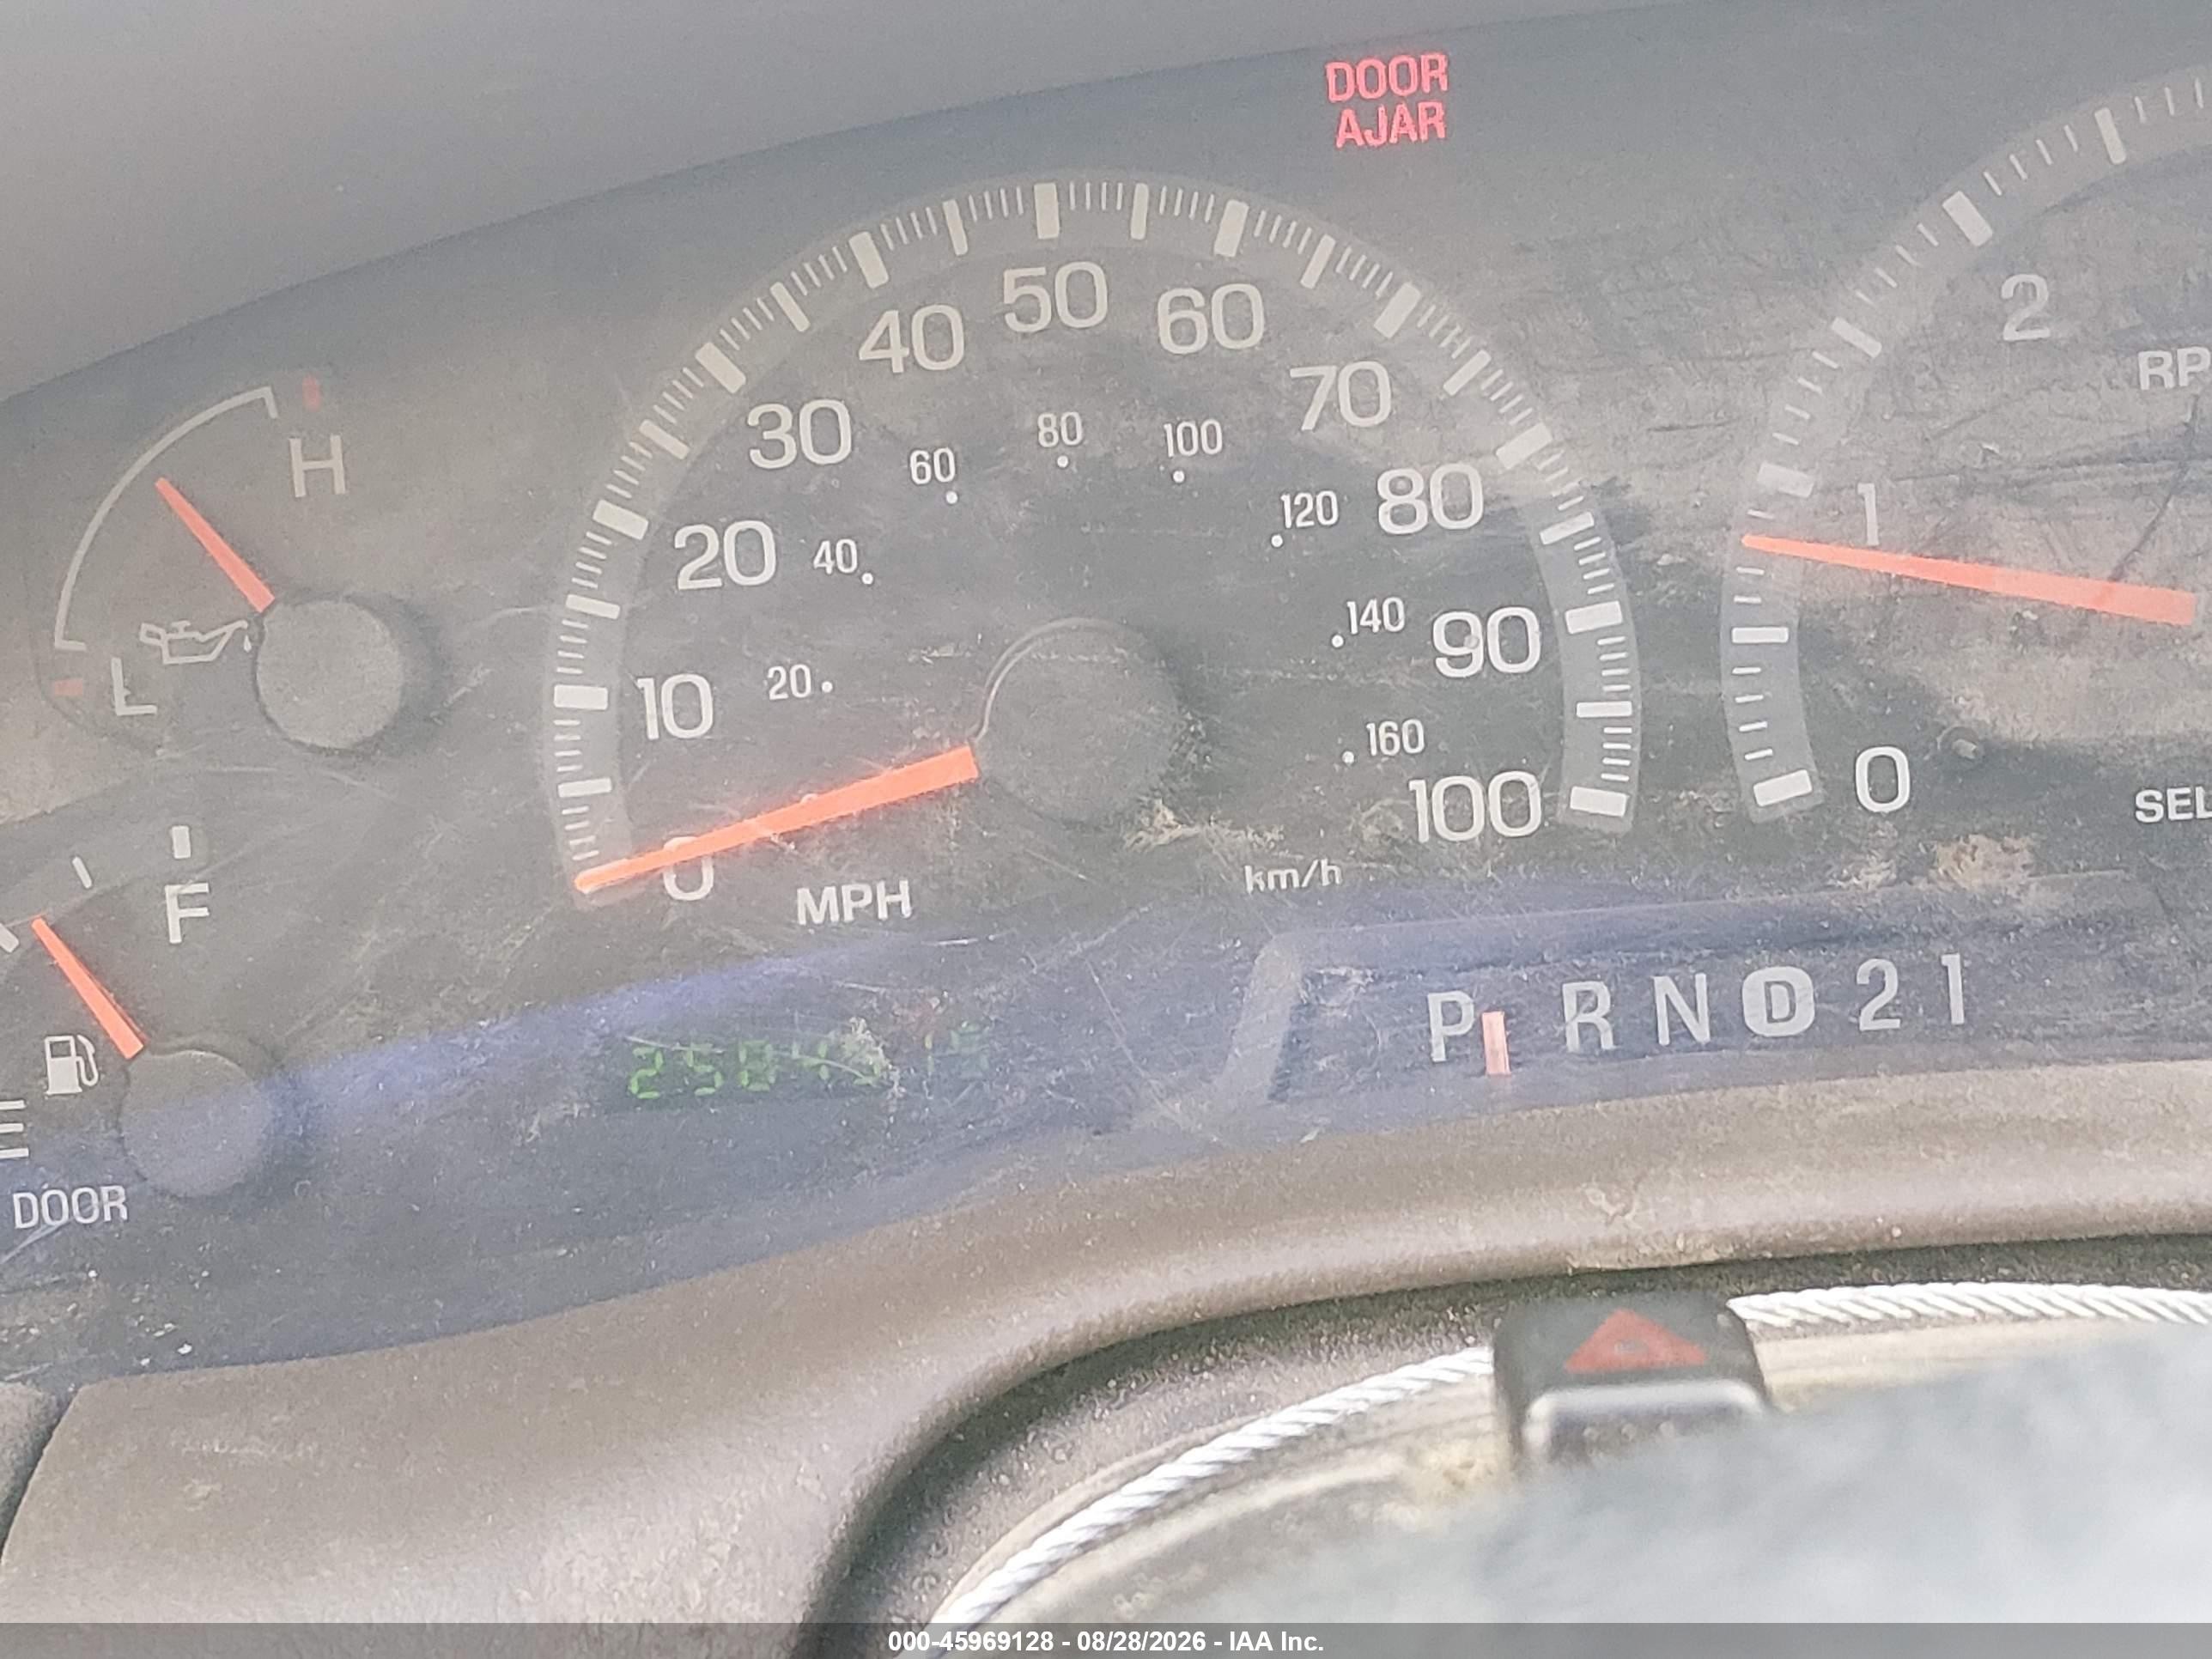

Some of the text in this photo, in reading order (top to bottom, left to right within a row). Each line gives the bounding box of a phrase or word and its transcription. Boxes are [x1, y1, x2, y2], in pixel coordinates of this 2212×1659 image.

[1326, 52, 1448, 102] DOOR
[1335, 100, 1446, 148] AJAR
[1003, 261, 1109, 332] 50
[1158, 283, 1265, 355] 60
[2001, 273, 2051, 342] 2
[859, 304, 965, 373] 40
[1290, 361, 1393, 430] 70
[747, 398, 853, 469] 30
[1037, 411, 1084, 447] 80
[1164, 419, 1223, 457] 100
[289, 434, 347, 498] H
[909, 447, 957, 485] 60
[1280, 490, 1340, 529] 120
[1376, 464, 1485, 535] 80
[1856, 483, 1879, 547] 1
[674, 520, 777, 591] 20
[813, 538, 859, 574] 40
[1346, 597, 1406, 635] 140
[1432, 606, 1541, 678] 90
[112, 657, 157, 715] L
[636, 673, 714, 740] 10
[768, 664, 812, 701] 20
[1366, 719, 1425, 757] 160
[1408, 769, 1542, 843] 100
[1855, 745, 1911, 813] 0
[661, 836, 714, 901] 0
[1245, 859, 1342, 893] km/h
[165, 882, 210, 944] F
[796, 879, 913, 925] MPH
[1427, 990, 1475, 1062] P
[1562, 980, 1615, 1052] R
[1653, 972, 1711, 1046] N
[1856, 957, 1901, 1030] 2
[1940, 953, 1966, 1025] 1
[12, 1185, 128, 1229] DOOR
